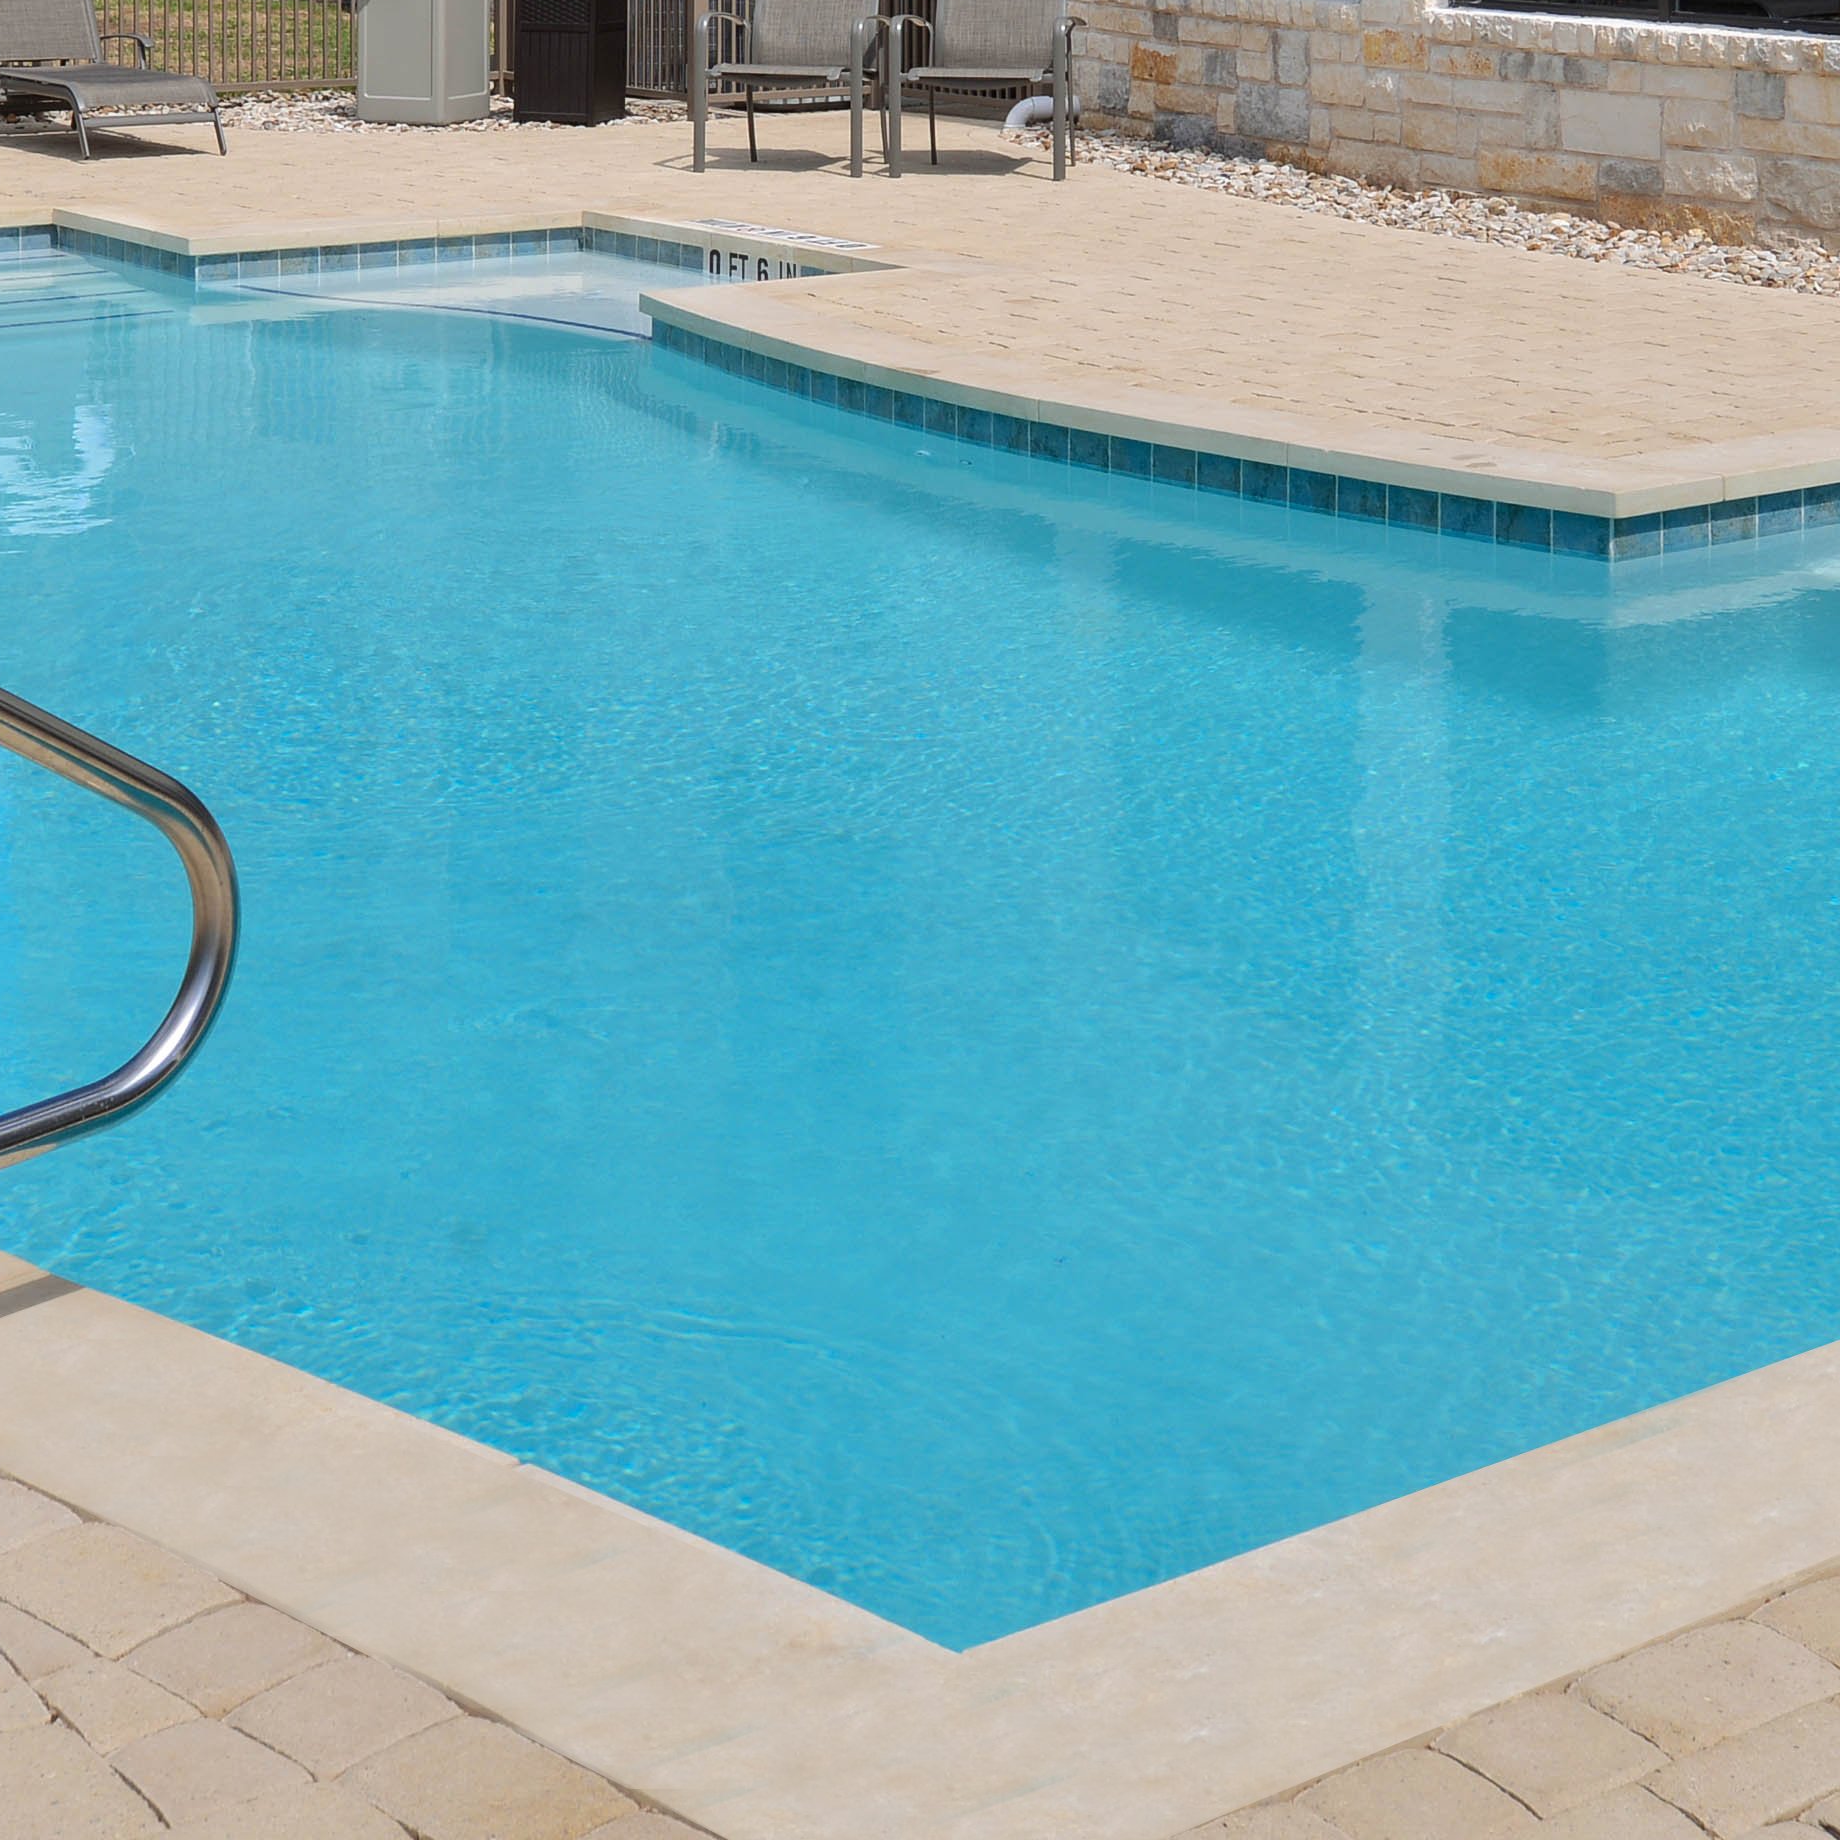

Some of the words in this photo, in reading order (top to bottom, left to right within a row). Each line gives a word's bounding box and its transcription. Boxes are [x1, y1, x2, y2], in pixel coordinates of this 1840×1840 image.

[729, 252, 749, 280] FT
[757, 257, 769, 281] 6
[779, 261, 797, 279] IN
